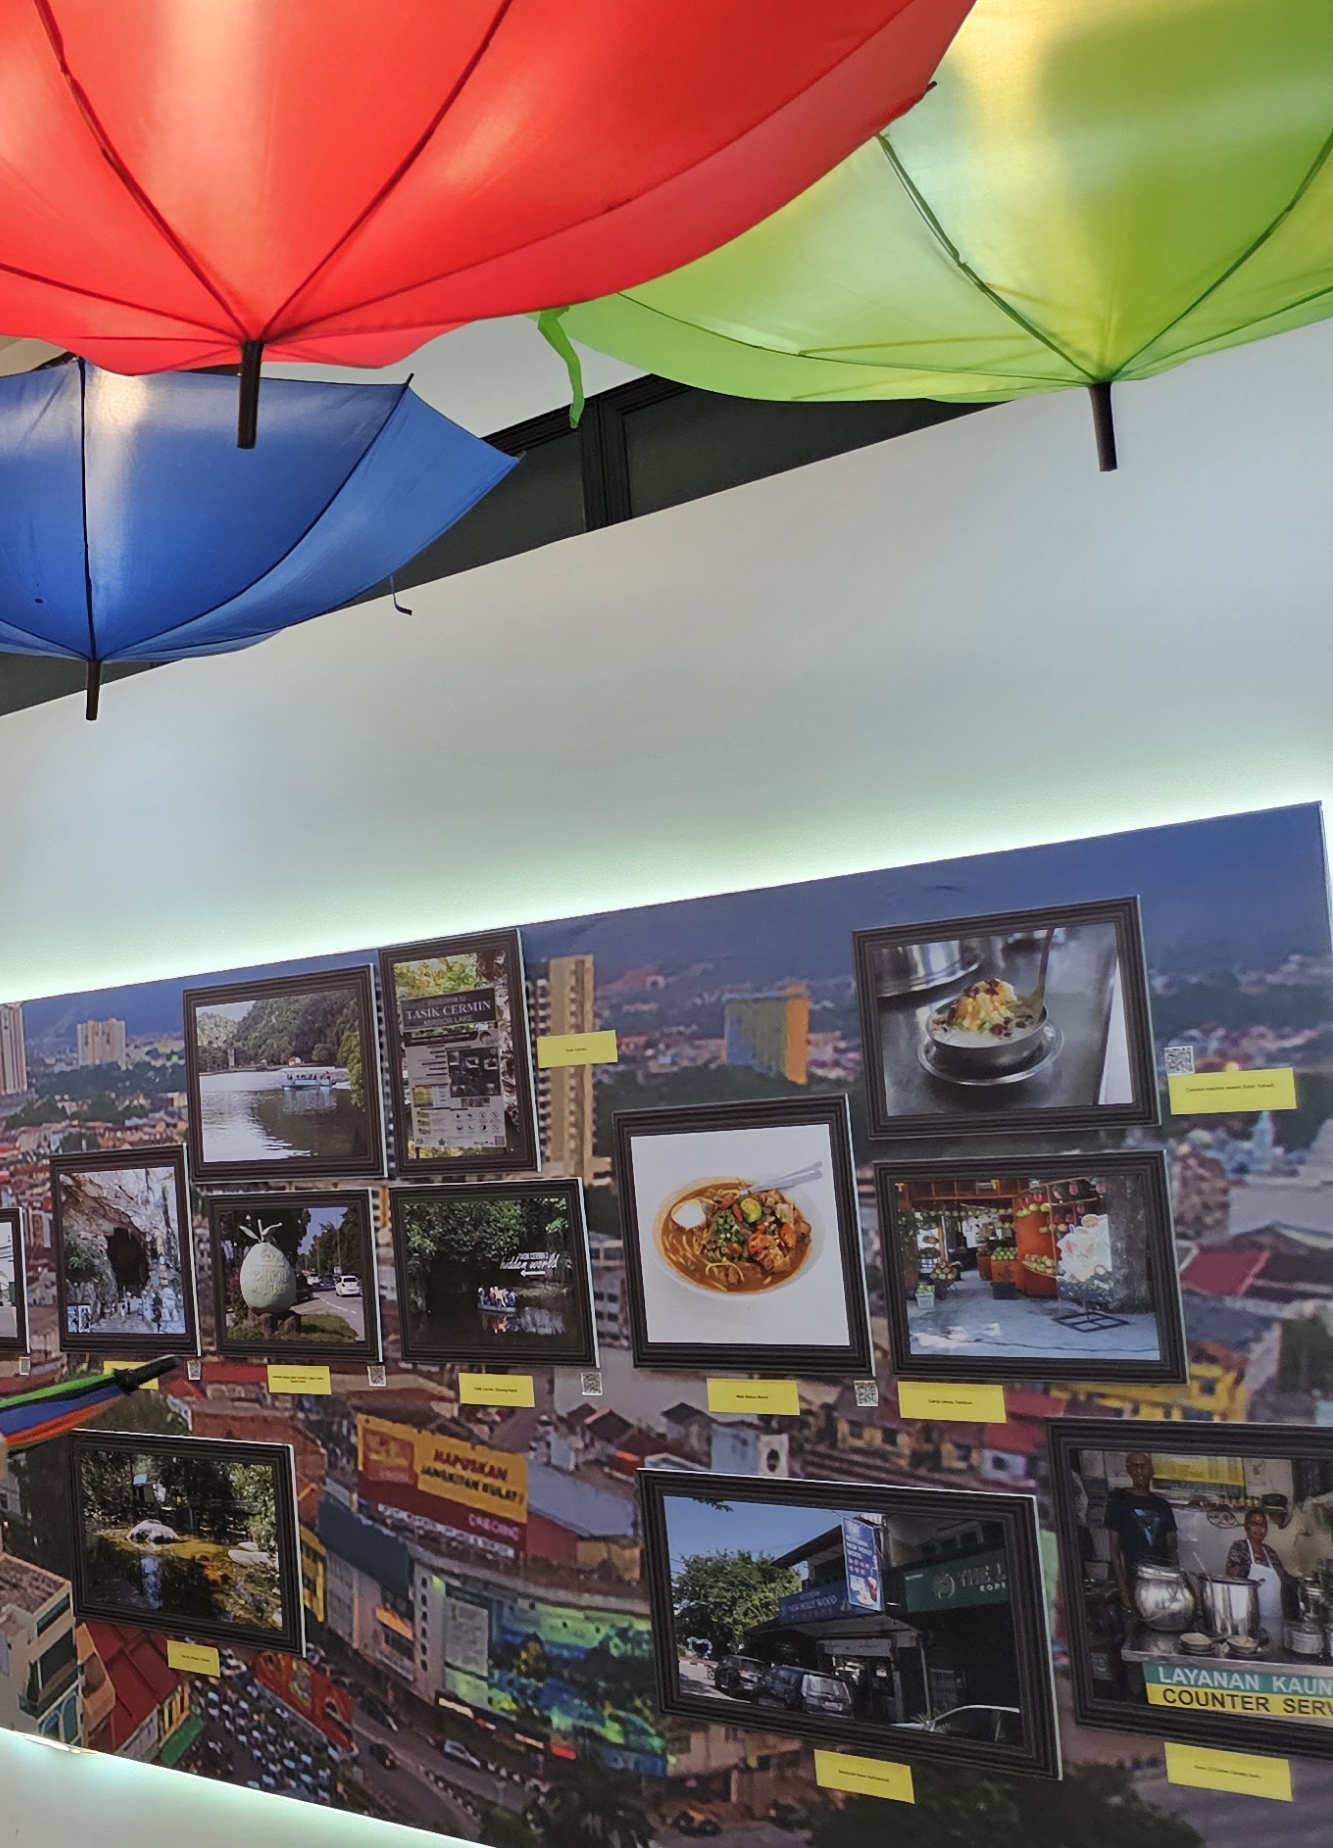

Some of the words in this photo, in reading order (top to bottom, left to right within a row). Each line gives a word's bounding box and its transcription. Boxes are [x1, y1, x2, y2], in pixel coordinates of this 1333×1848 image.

[406, 1007, 440, 1019] TASIK
[443, 1000, 491, 1015] CERMIN
[530, 1252, 560, 1269] world
[1158, 1666, 1260, 1691] LAYANAN
[1271, 1676, 1333, 1696] KAUN
[1162, 1688, 1271, 1713] COUNTER
